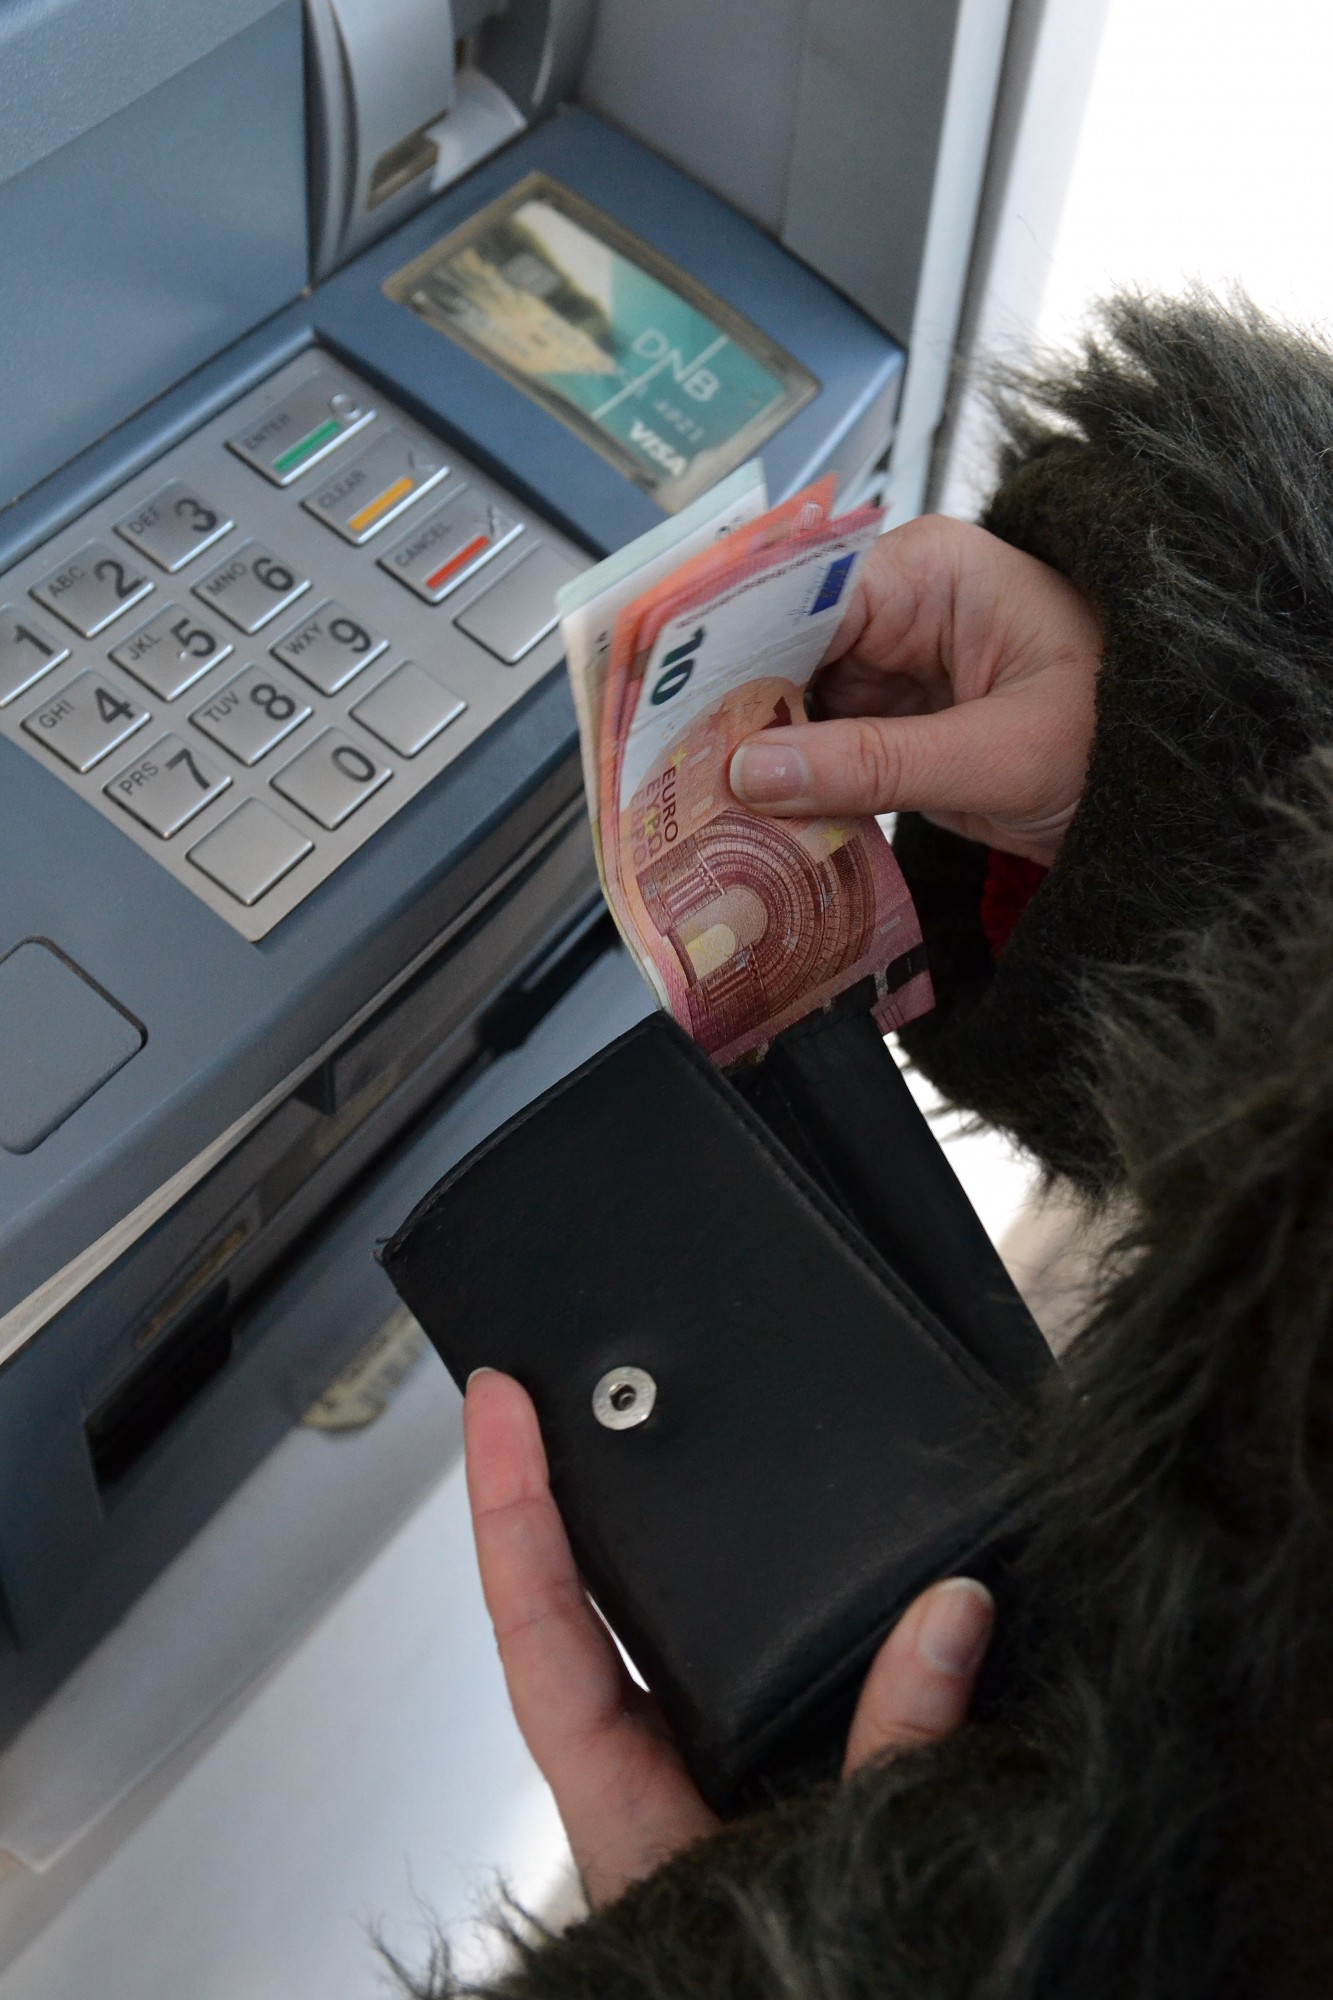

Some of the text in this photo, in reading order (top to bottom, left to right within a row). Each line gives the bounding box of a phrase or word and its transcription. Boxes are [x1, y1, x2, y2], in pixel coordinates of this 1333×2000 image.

[630, 328, 721, 402] DNB
[244, 412, 291, 450] ENTER
[628, 418, 688, 477] VISA
[317, 468, 366, 508] CLEAR
[128, 497, 217, 535] DEF 3
[394, 521, 452, 568] CANCEL
[47, 559, 146, 599] ABC 2
[206, 557, 294, 596] MNO 6
[14, 624, 54, 657] 1
[129, 617, 216, 661] JKL 5
[286, 617, 371, 656] WXY 9
[650, 625, 706, 706] 10
[38, 686, 136, 732] GHI 4
[204, 683, 296, 723] TUV 8
[119, 747, 211, 796] PRS 7
[331, 745, 376, 783] 0
[661, 765, 679, 843] EURO
